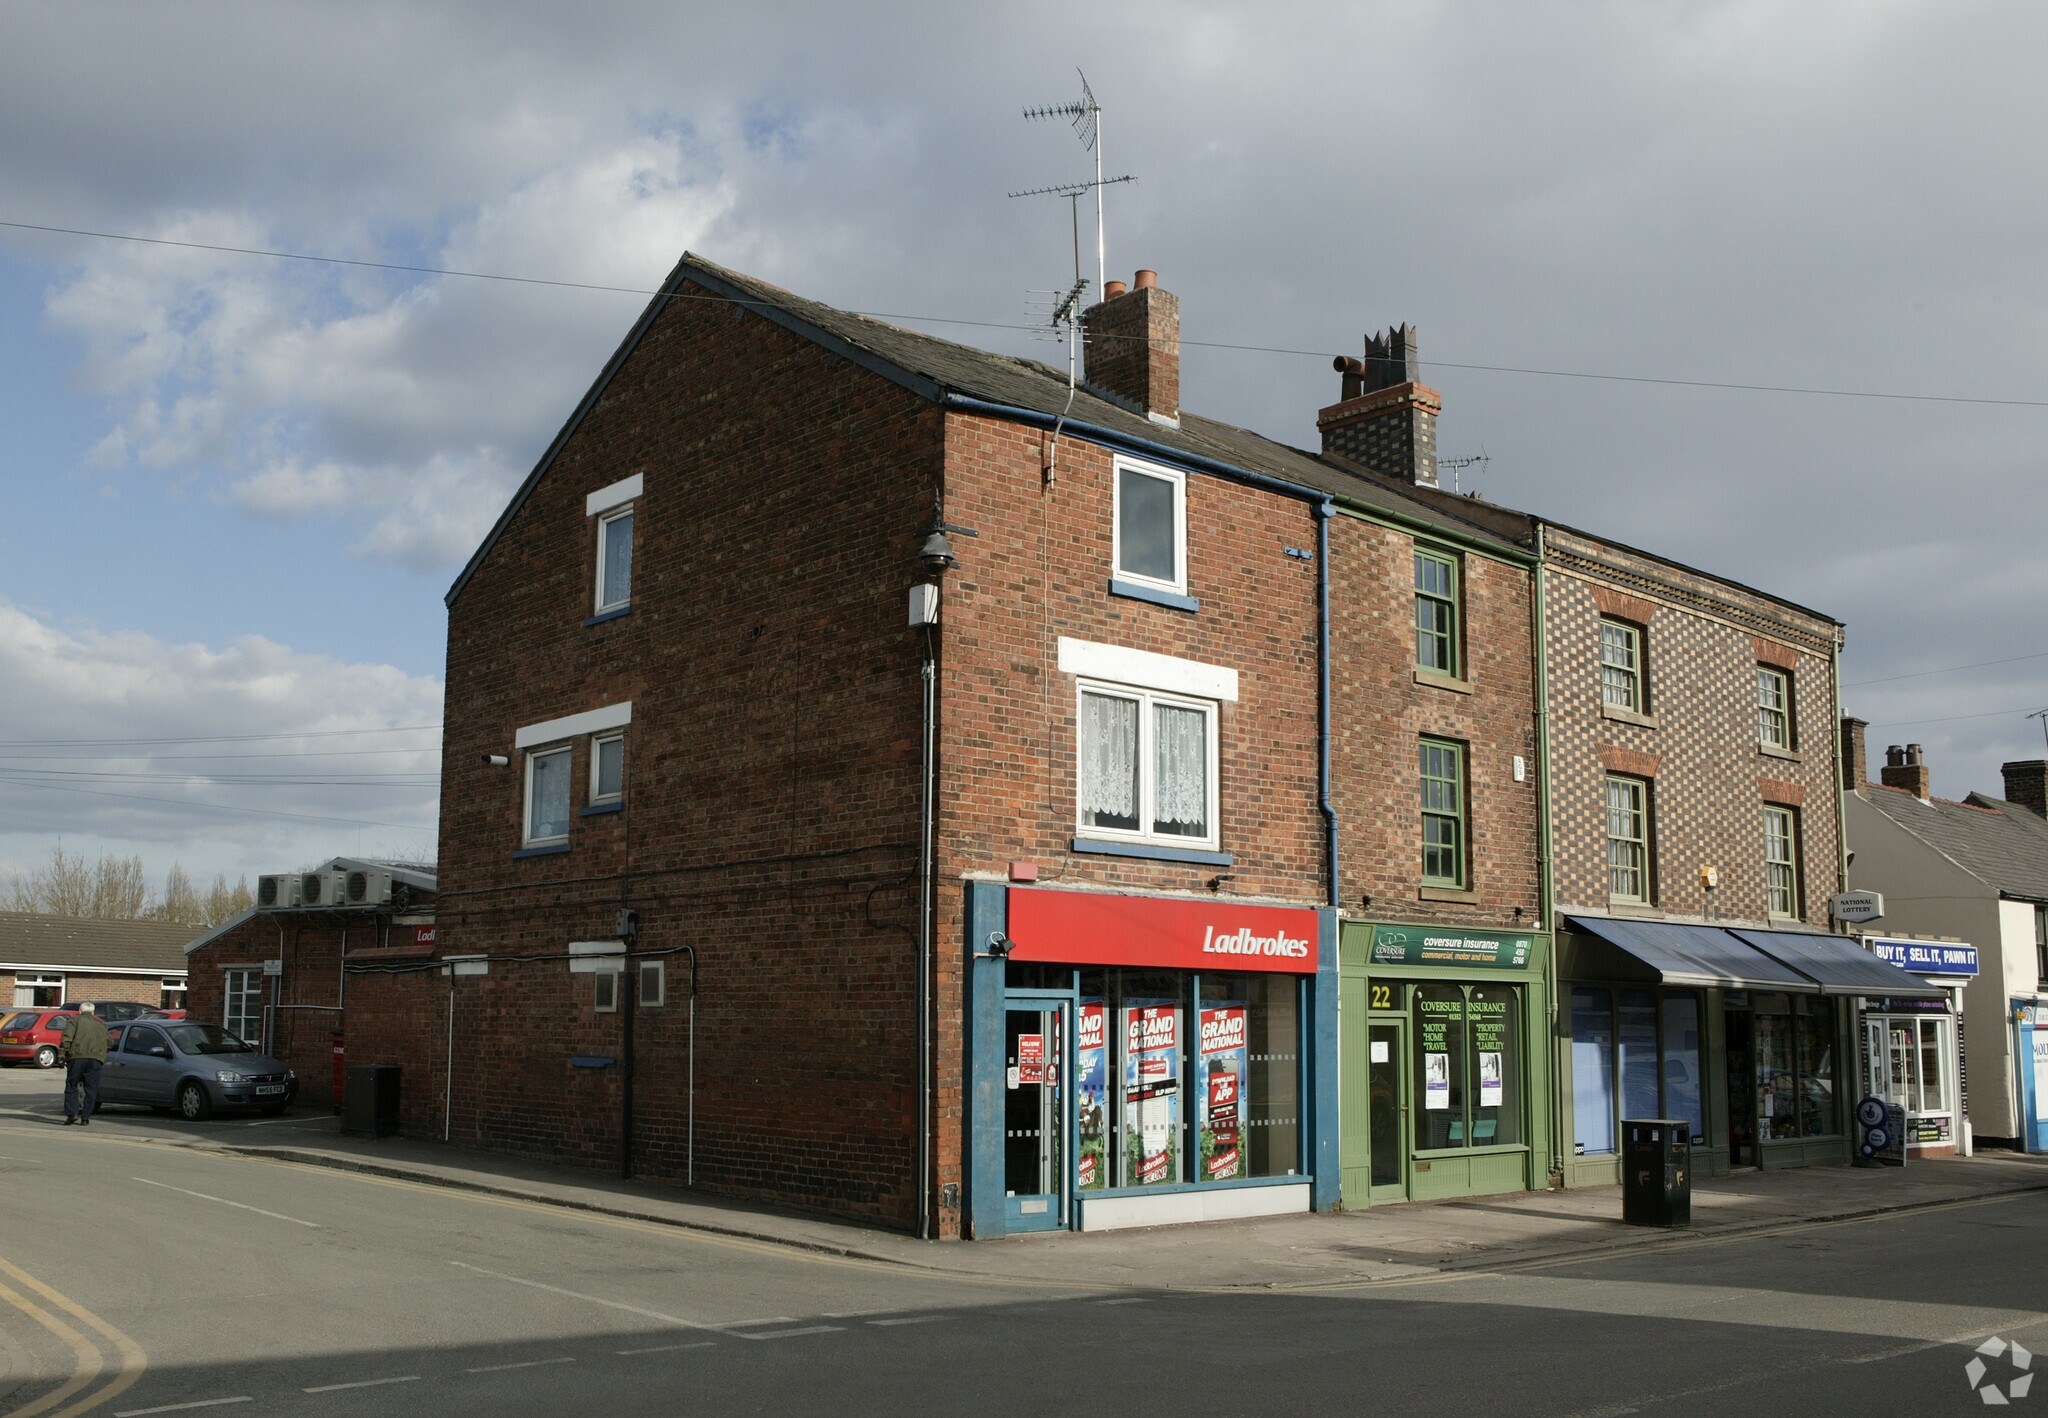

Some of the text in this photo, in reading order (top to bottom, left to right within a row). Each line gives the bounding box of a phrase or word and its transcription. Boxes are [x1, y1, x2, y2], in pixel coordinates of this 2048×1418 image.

[1203, 925, 1309, 957] Ladbrokes
[1423, 937, 1499, 949] coversure insurance
[1421, 951, 1453, 961] commercial,
[1482, 953, 1496, 961] home
[1876, 945, 1975, 965] BUY IT, SELL IT, PAWN IT
[1372, 986, 1391, 1007] 22
[1144, 1008, 1158, 1019] THE
[1421, 1001, 1506, 1012] COVERSURE INSURANCE
[1214, 1010, 1228, 1020] THE
[1079, 1014, 1102, 1033] AND
[1129, 1016, 1174, 1037] GRAND
[1202, 1016, 1243, 1039] GRAND
[1425, 1023, 1447, 1032] MOTOR
[1477, 1023, 1506, 1032] PROPERTY
[1079, 1032, 1102, 1046] ONAL
[1129, 1032, 1174, 1050] NATIONAL
[1202, 1033, 1243, 1051] NATIONAL
[1425, 1033, 1443, 1041] HOME
[1477, 1033, 1497, 1041] RETAIL
[1425, 1042, 1447, 1050] TRAVEL
[1478, 1042, 1504, 1050] LIABILITY
[1215, 1087, 1233, 1102] APP
[1138, 1153, 1165, 1173] Ladbrokes
[1210, 1151, 1236, 1170] Ladbrokes
[1153, 1165, 1168, 1181] ON!
[1224, 1162, 1238, 1178] ON!
